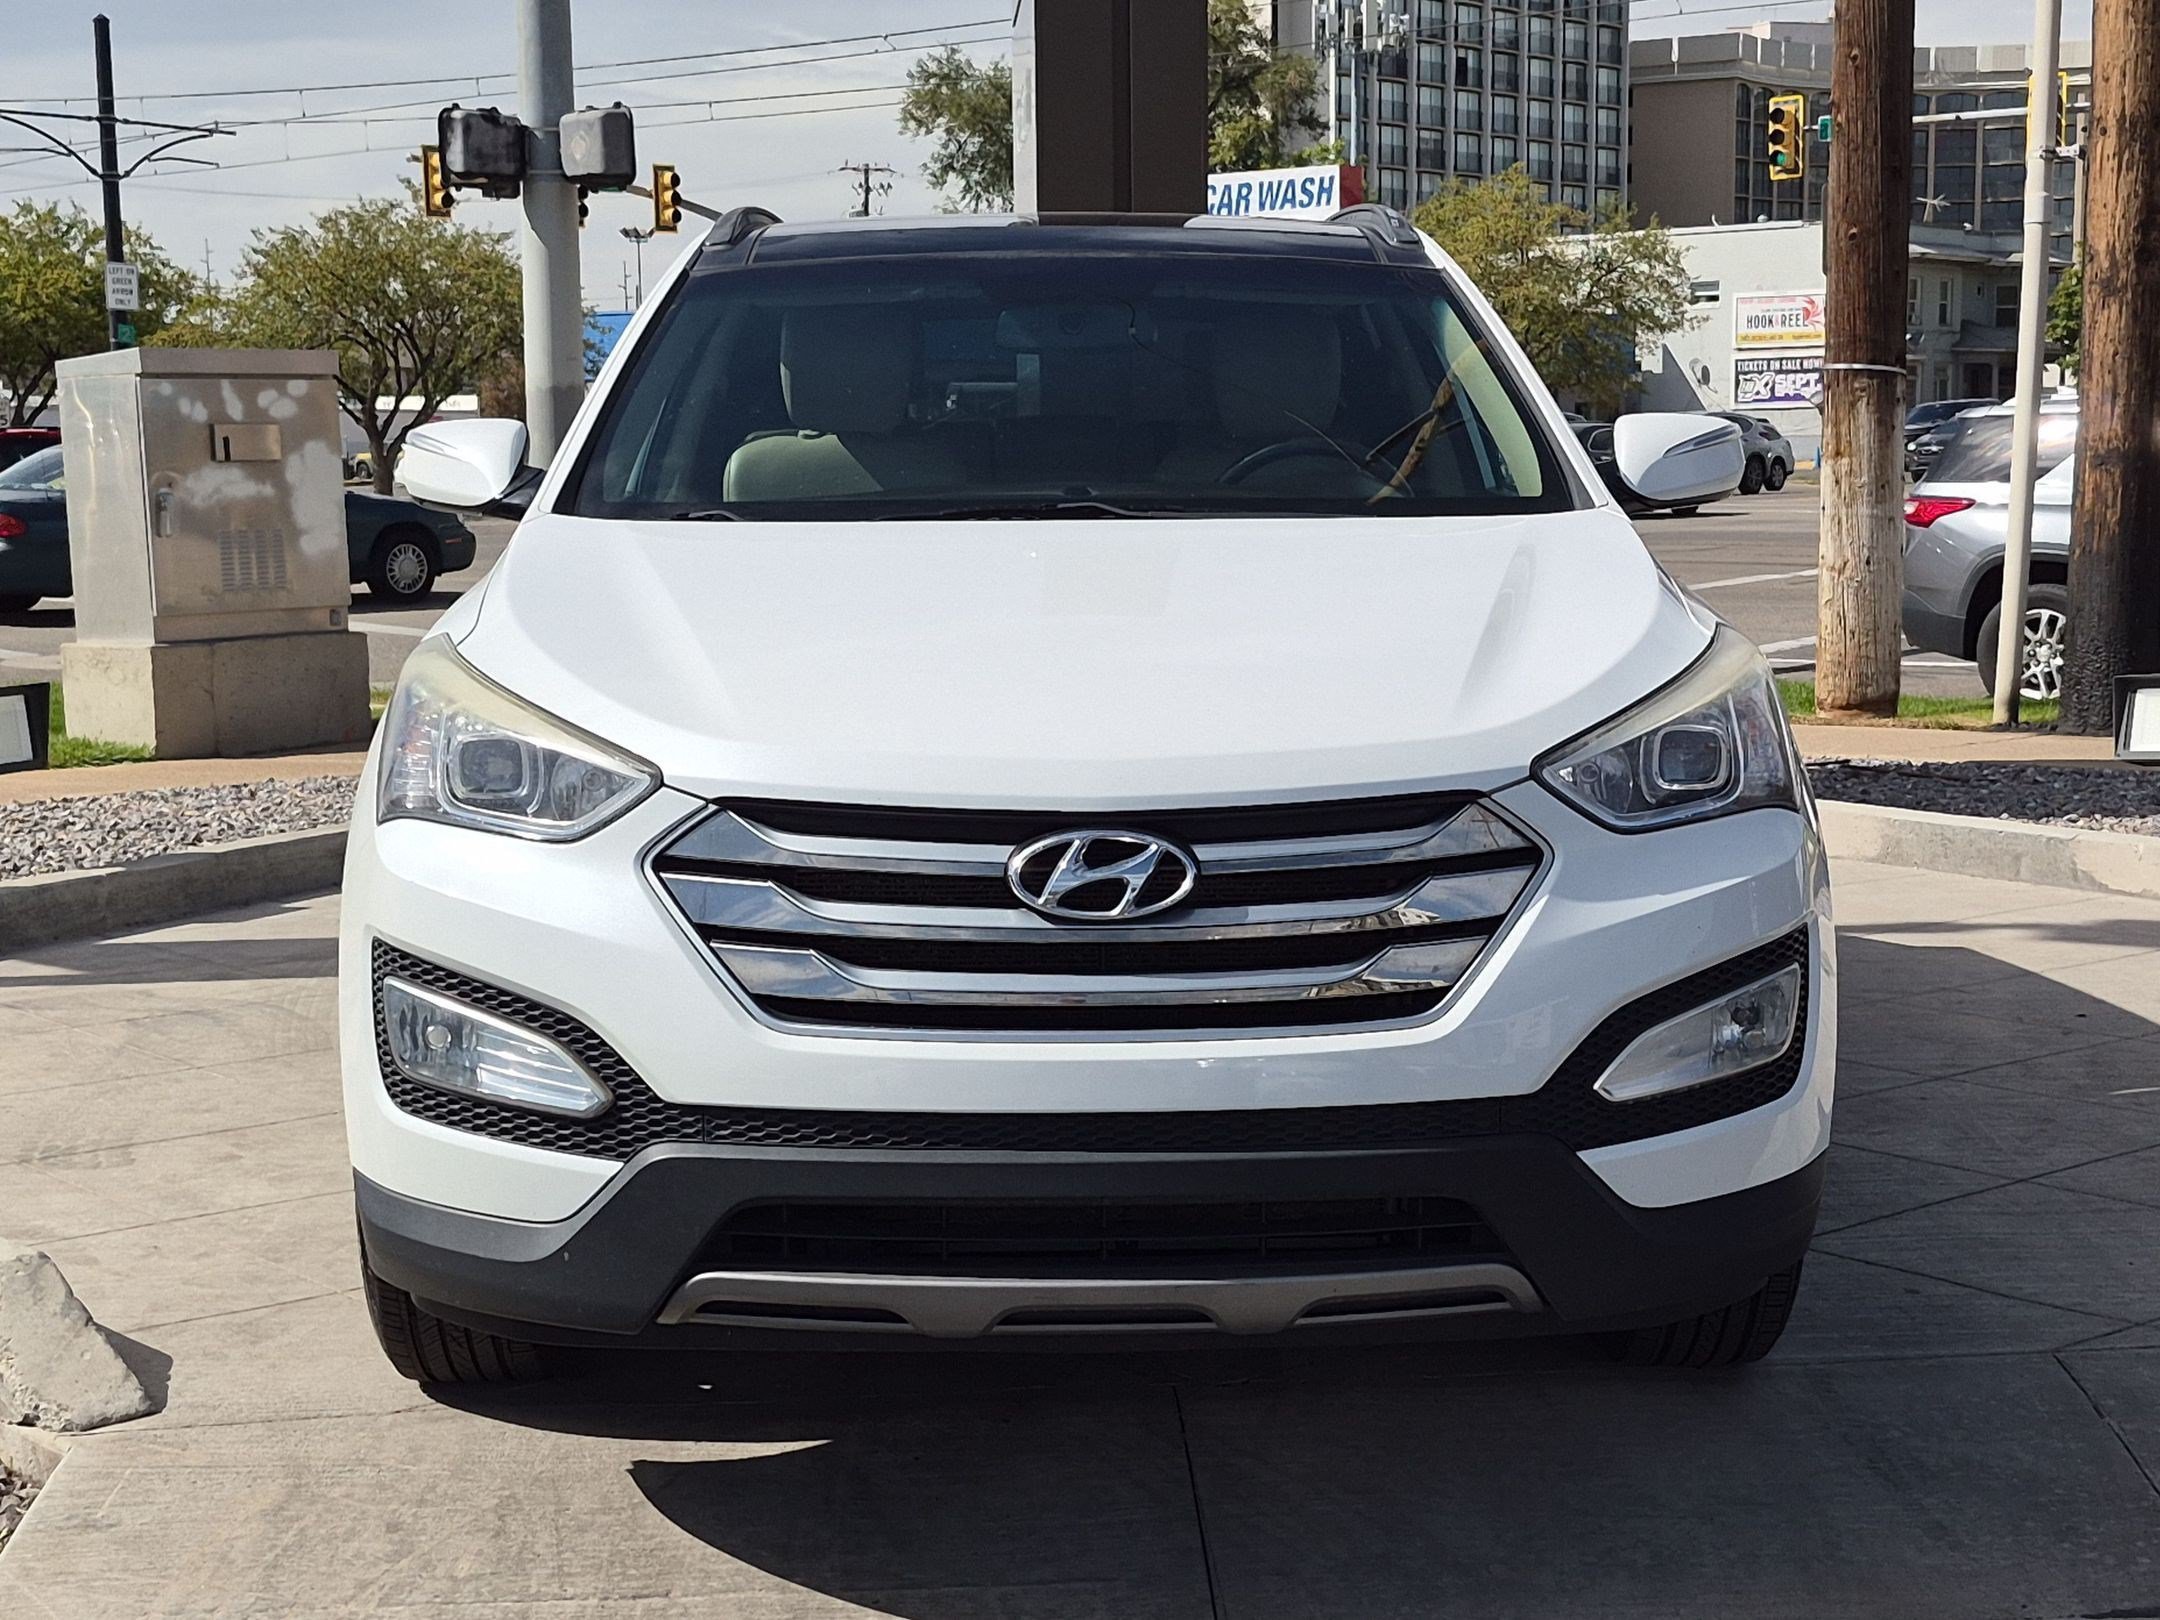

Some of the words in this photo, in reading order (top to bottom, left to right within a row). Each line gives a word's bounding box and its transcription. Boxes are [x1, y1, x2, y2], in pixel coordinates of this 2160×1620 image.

[1208, 182, 1252, 216] CAR
[1258, 175, 1335, 212] WASH
[1737, 360, 1768, 372] TICKETS
[1770, 360, 1780, 371] ON
[1782, 359, 1801, 370] SALE
